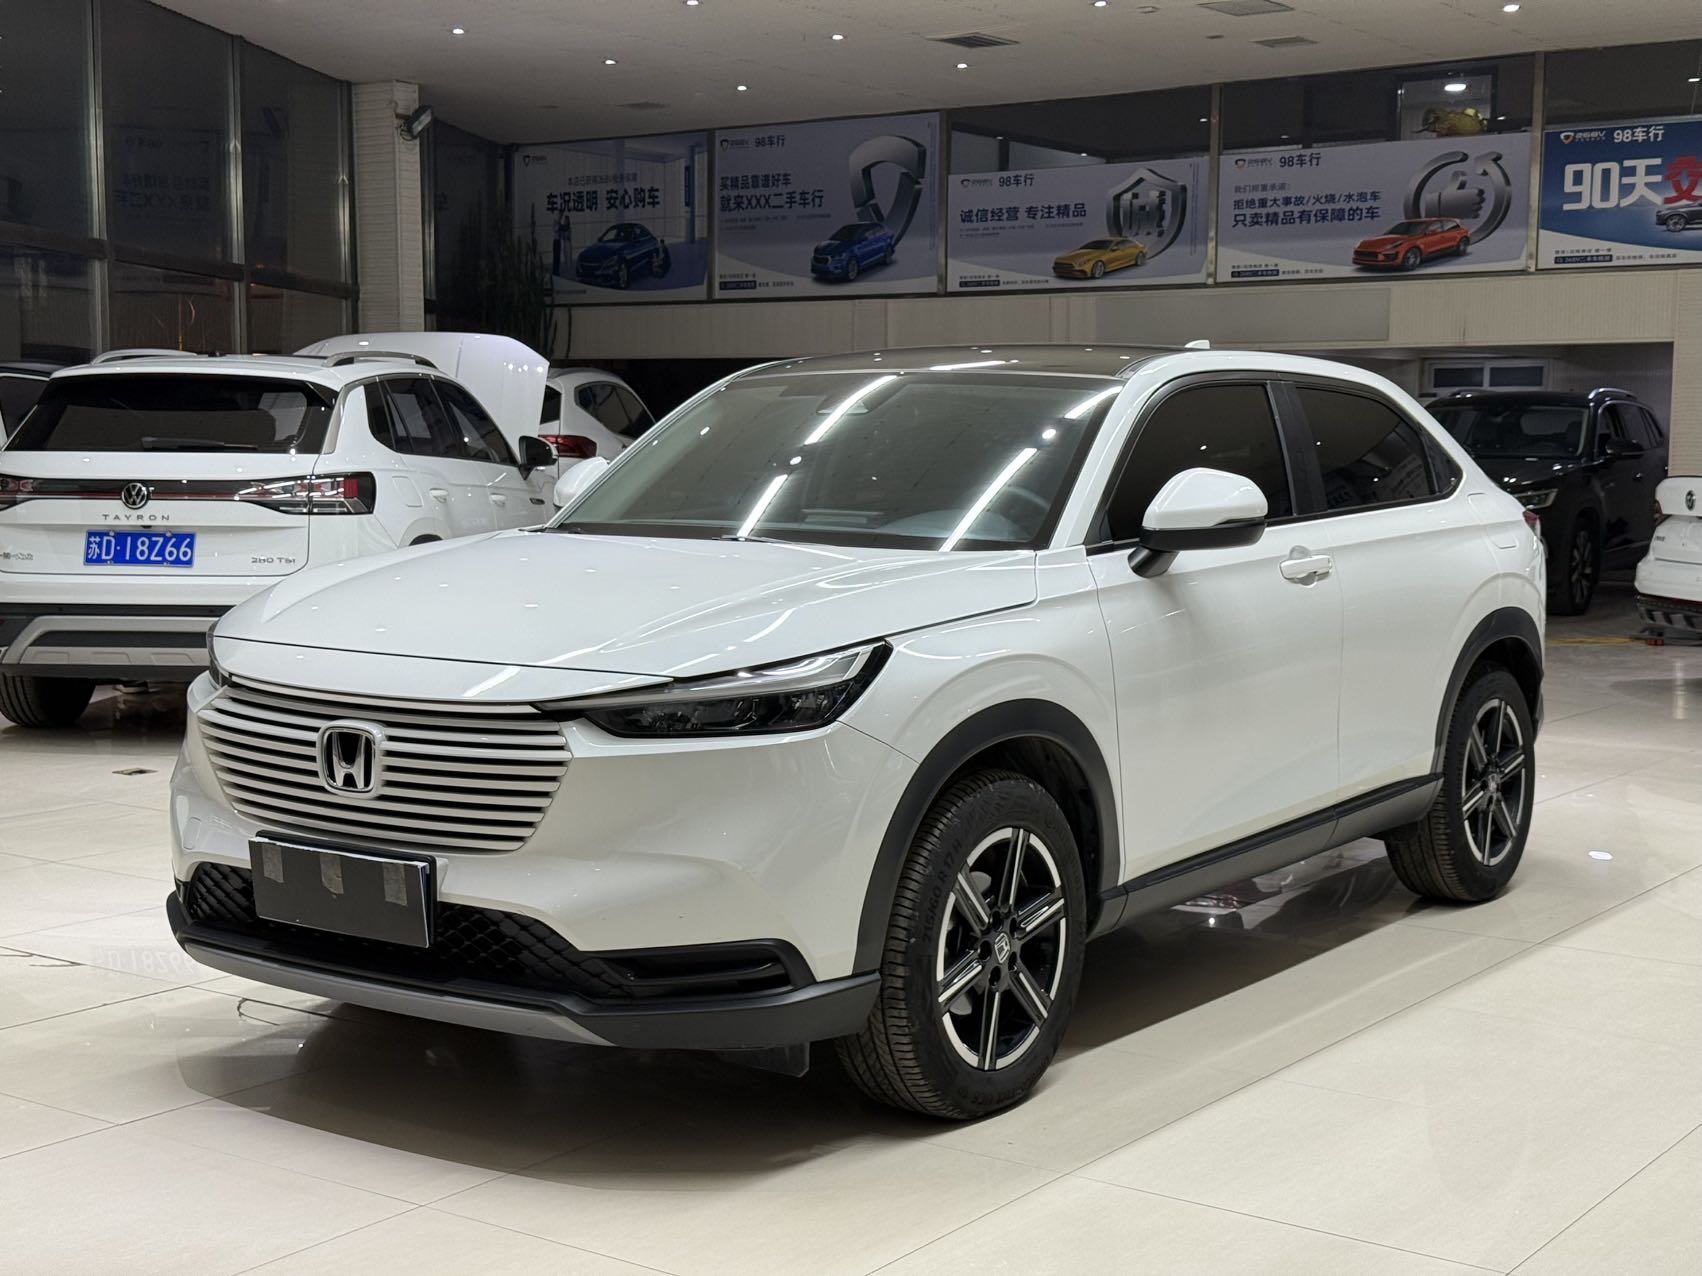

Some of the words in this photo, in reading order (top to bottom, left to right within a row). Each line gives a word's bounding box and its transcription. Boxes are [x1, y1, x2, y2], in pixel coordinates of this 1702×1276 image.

[754, 135, 786, 148] 98车行
[1613, 125, 1665, 143] 98车行
[1279, 152, 1322, 168] 98车行
[998, 173, 1035, 188] 98车行
[546, 189, 599, 214] 车况透明
[606, 186, 660, 211] 安心购车
[720, 189, 824, 212] 就来XXX二手车行
[1233, 190, 1382, 211] 拒绝重大事故/火烧/水泡车
[960, 206, 1020, 224] 诚信经营
[1025, 203, 1087, 220] 专注精品
[1232, 205, 1381, 229] 只卖精品有保障的车
[102, 513, 171, 521] TAYRON
